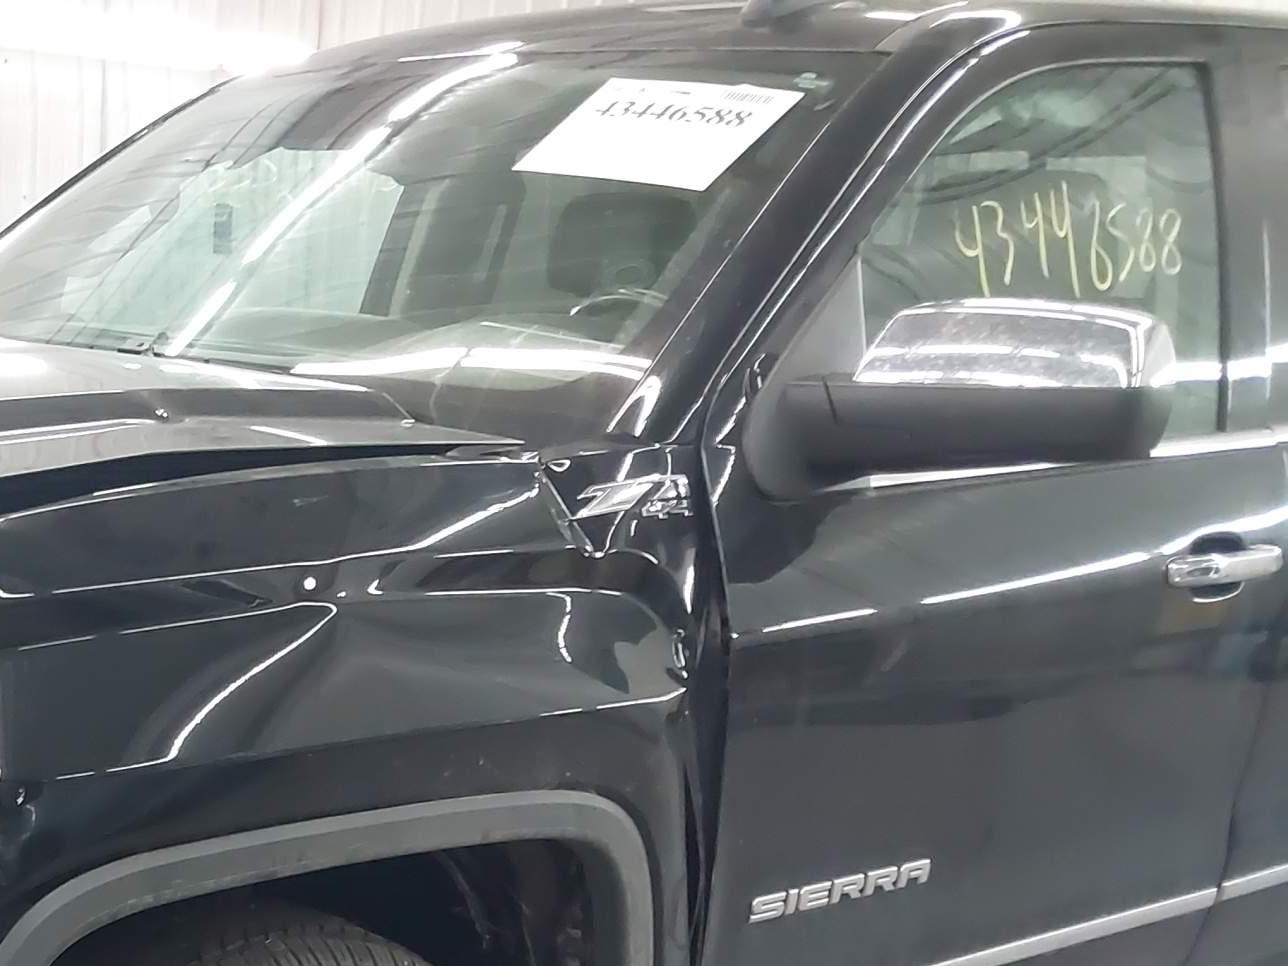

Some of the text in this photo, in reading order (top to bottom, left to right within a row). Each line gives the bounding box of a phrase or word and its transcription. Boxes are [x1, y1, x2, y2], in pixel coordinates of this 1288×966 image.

[595, 100, 753, 128] 43446588
[954, 180, 1183, 298] 43446588
[748, 858, 932, 923] SIERRA
